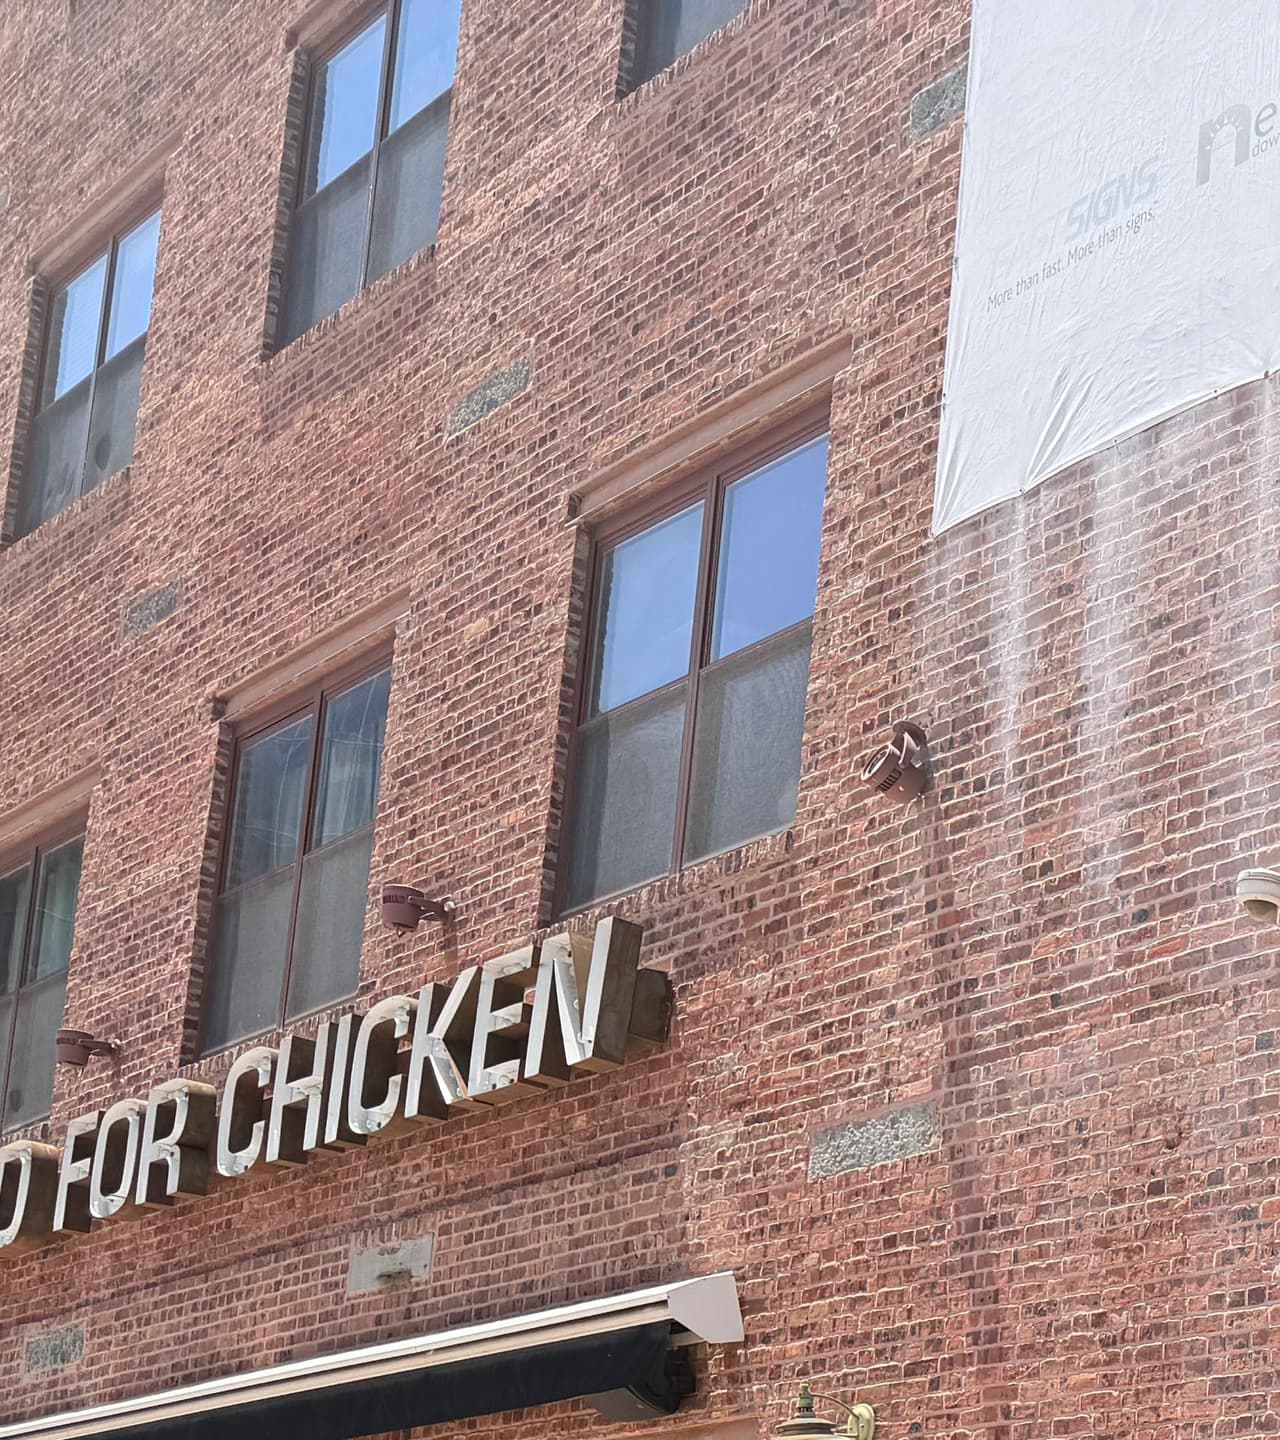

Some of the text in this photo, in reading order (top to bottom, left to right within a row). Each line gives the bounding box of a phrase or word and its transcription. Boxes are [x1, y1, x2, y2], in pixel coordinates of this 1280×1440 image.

[987, 207, 1156, 312] More than fast. More than signs.
[53, 1078, 205, 1233] FOR
[216, 916, 632, 1178] CHICKEN
